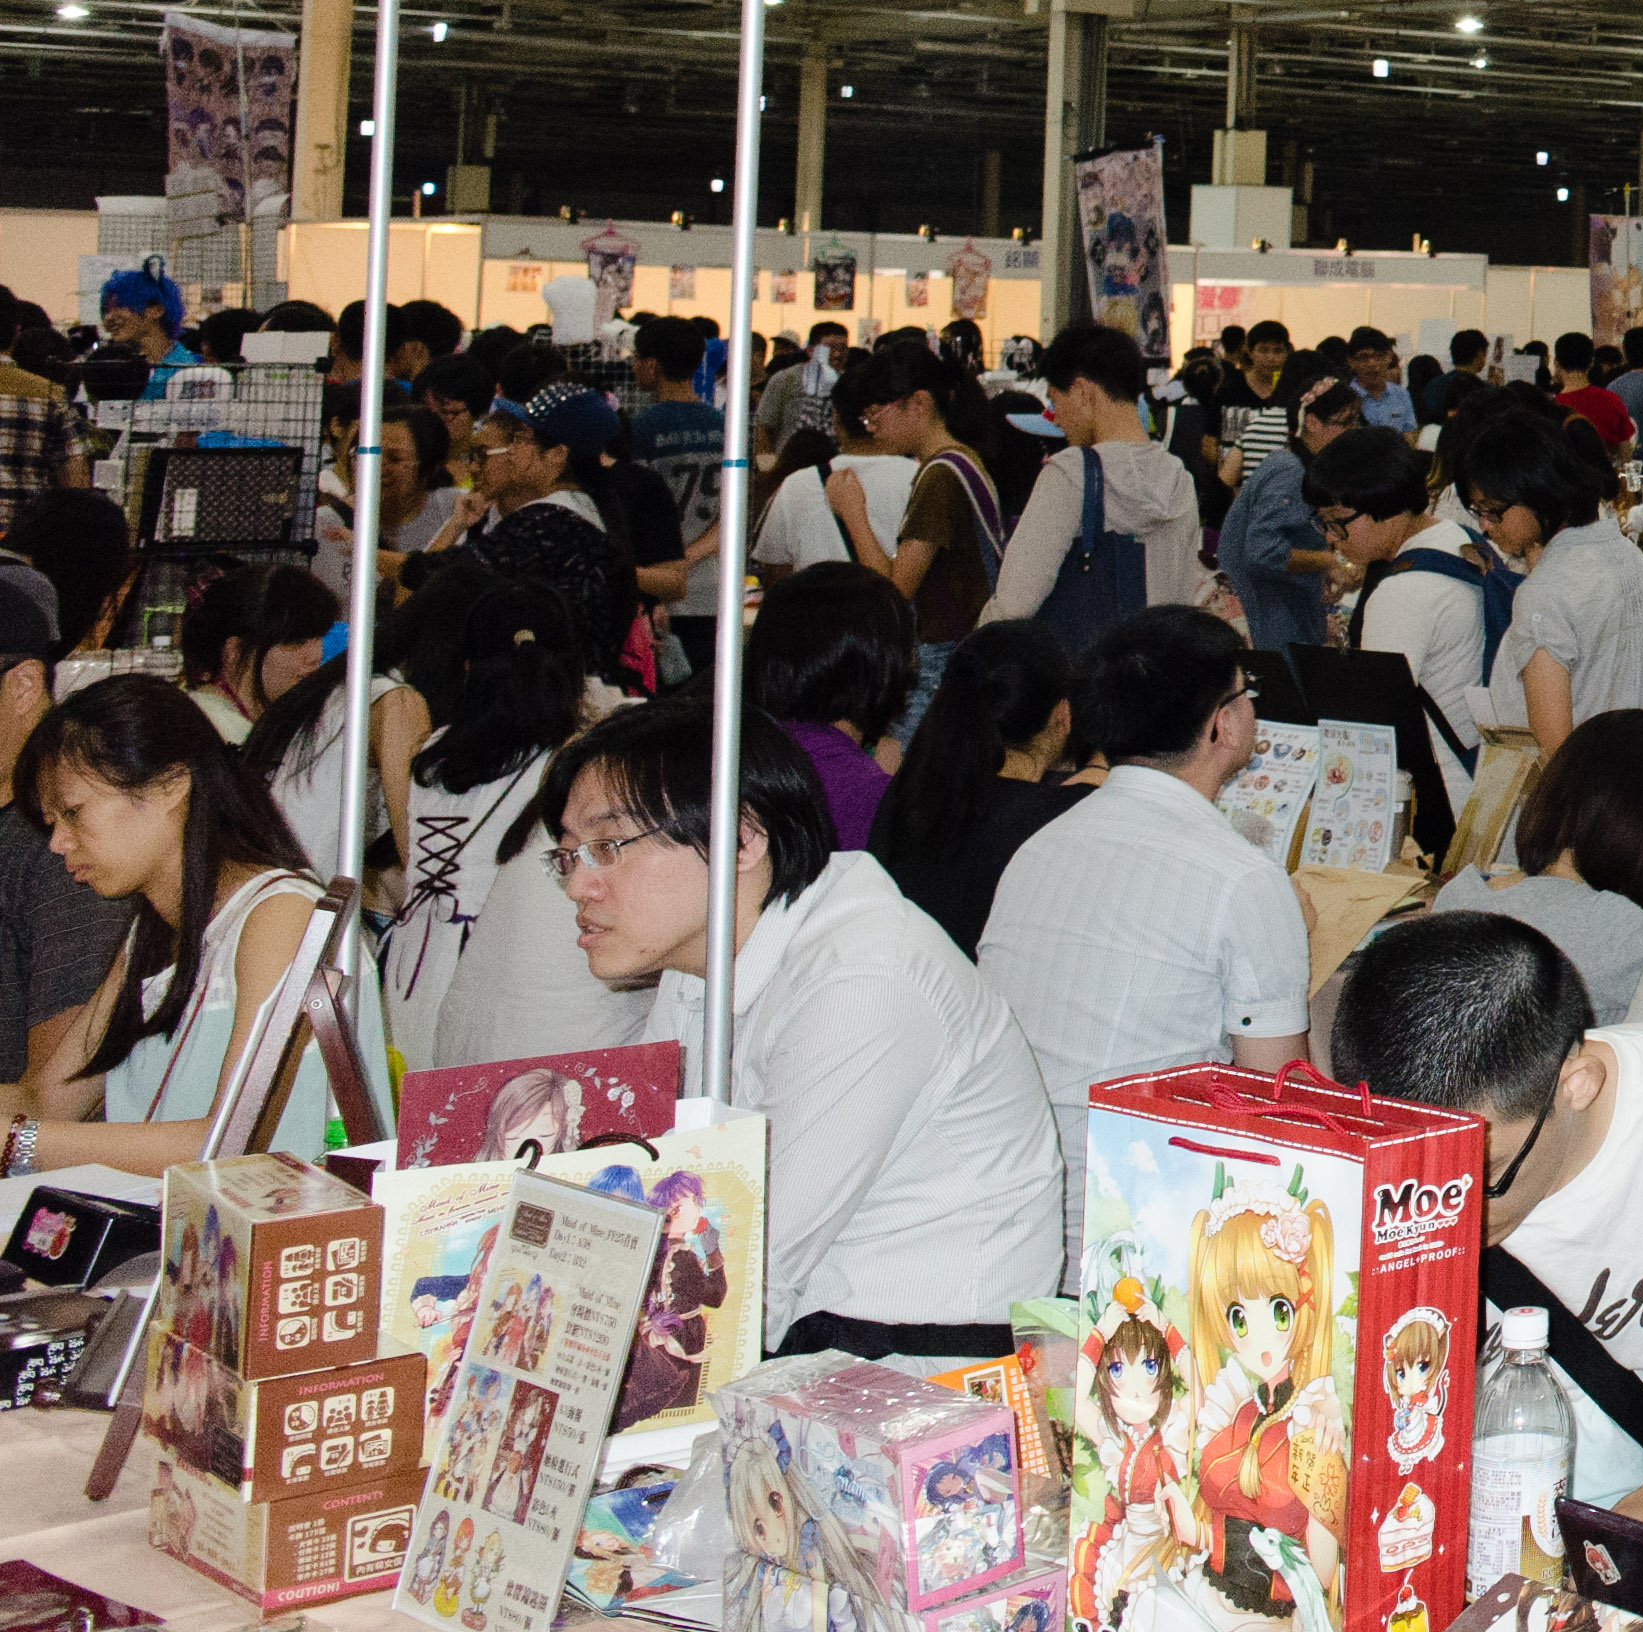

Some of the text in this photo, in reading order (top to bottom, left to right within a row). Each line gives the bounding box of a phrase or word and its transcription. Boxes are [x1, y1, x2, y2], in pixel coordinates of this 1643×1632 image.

[1375, 1178, 1466, 1230] Moe
[259, 1260, 273, 1342] INFORMATION
[299, 1372, 385, 1396] INFORMATION
[322, 1490, 384, 1510] CONTENTS
